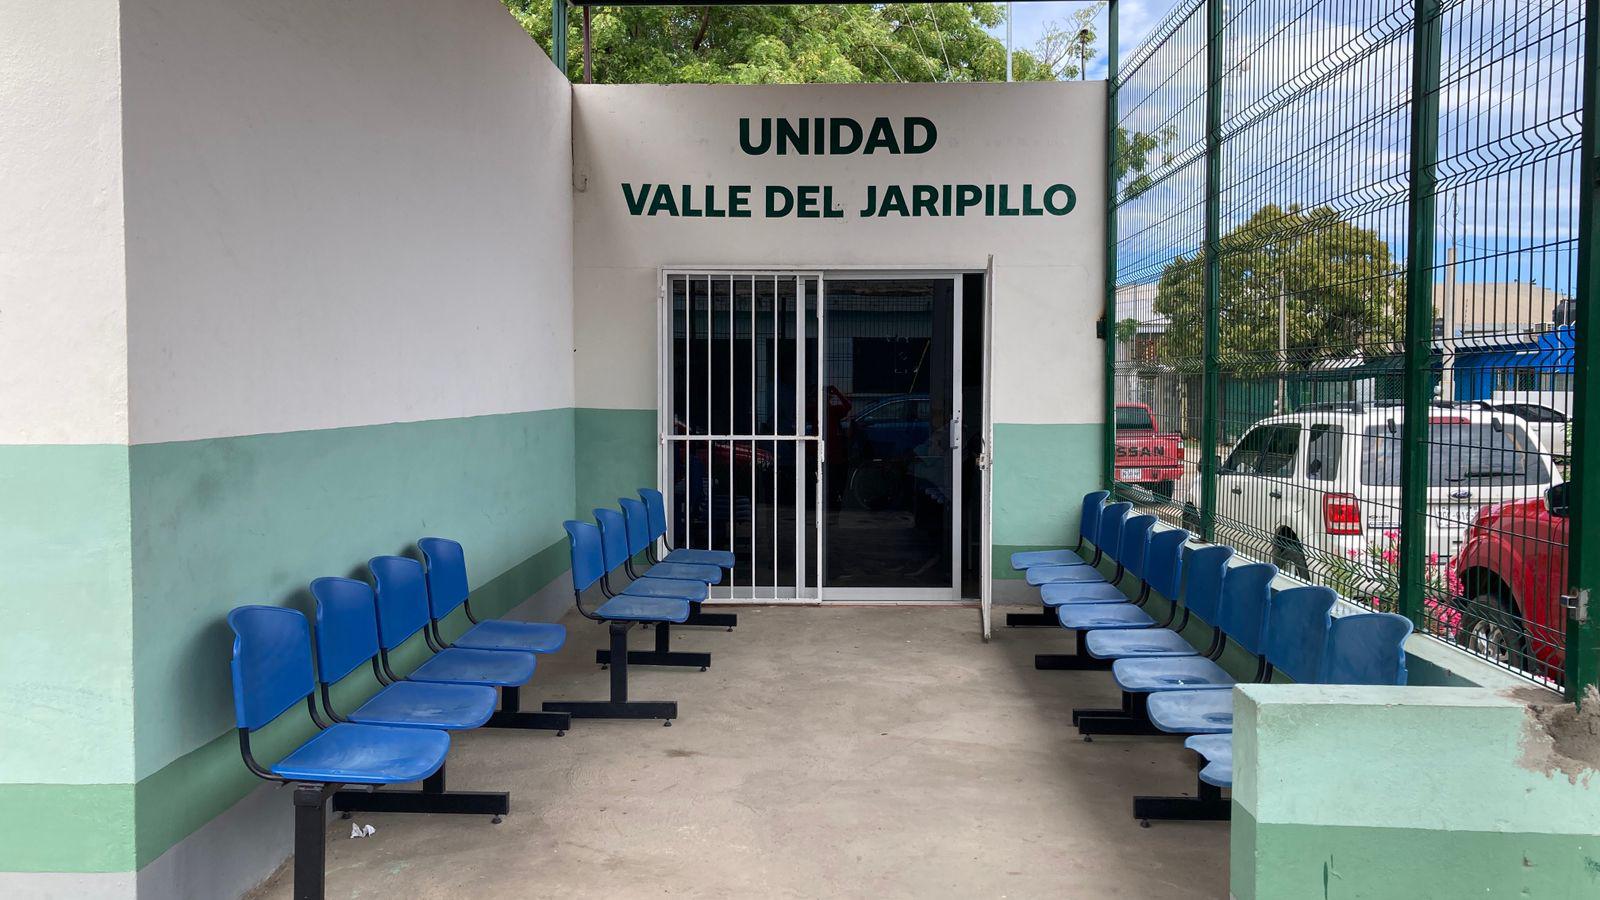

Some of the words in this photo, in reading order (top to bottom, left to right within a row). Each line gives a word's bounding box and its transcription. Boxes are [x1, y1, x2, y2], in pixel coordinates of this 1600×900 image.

[739, 117, 938, 156] UNIDAD
[620, 182, 752, 218] VALLE
[765, 184, 844, 219] DEL
[859, 183, 1077, 218] JARIPILLO
[1116, 446, 1165, 458] SSAN
